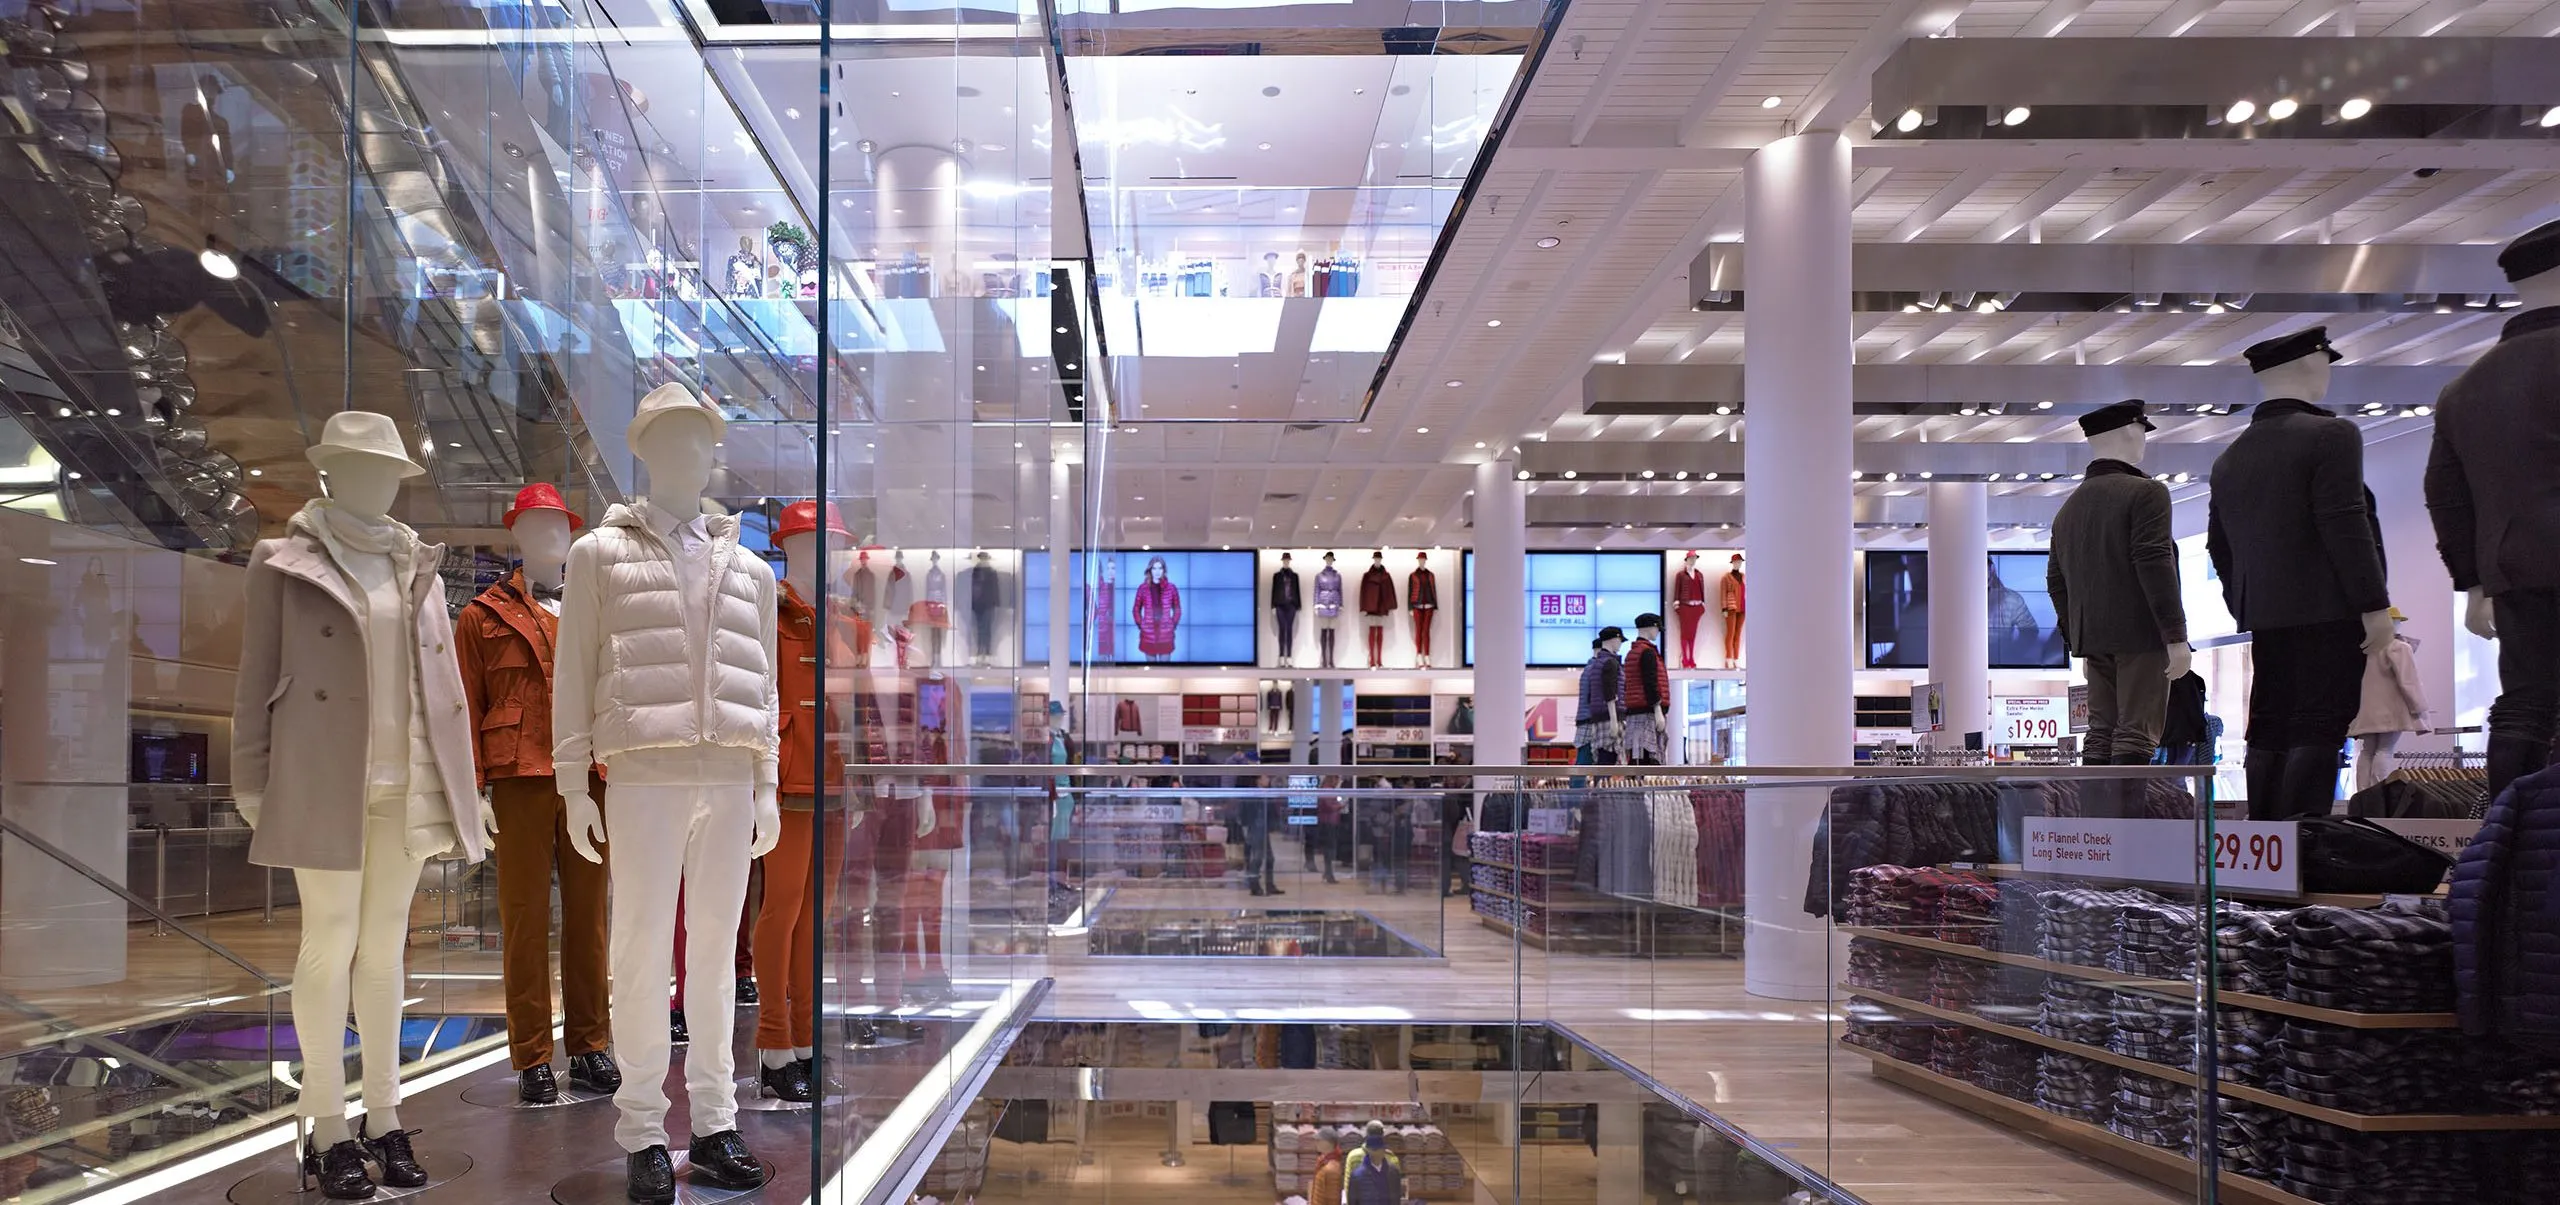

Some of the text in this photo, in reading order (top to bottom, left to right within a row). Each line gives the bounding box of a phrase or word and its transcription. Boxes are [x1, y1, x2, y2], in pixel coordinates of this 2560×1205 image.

[2008, 720, 2056, 738] $19.90
[2032, 831, 2111, 845] M's Flannel Check
[2032, 846, 2111, 861] Long Sleeve Shirt
